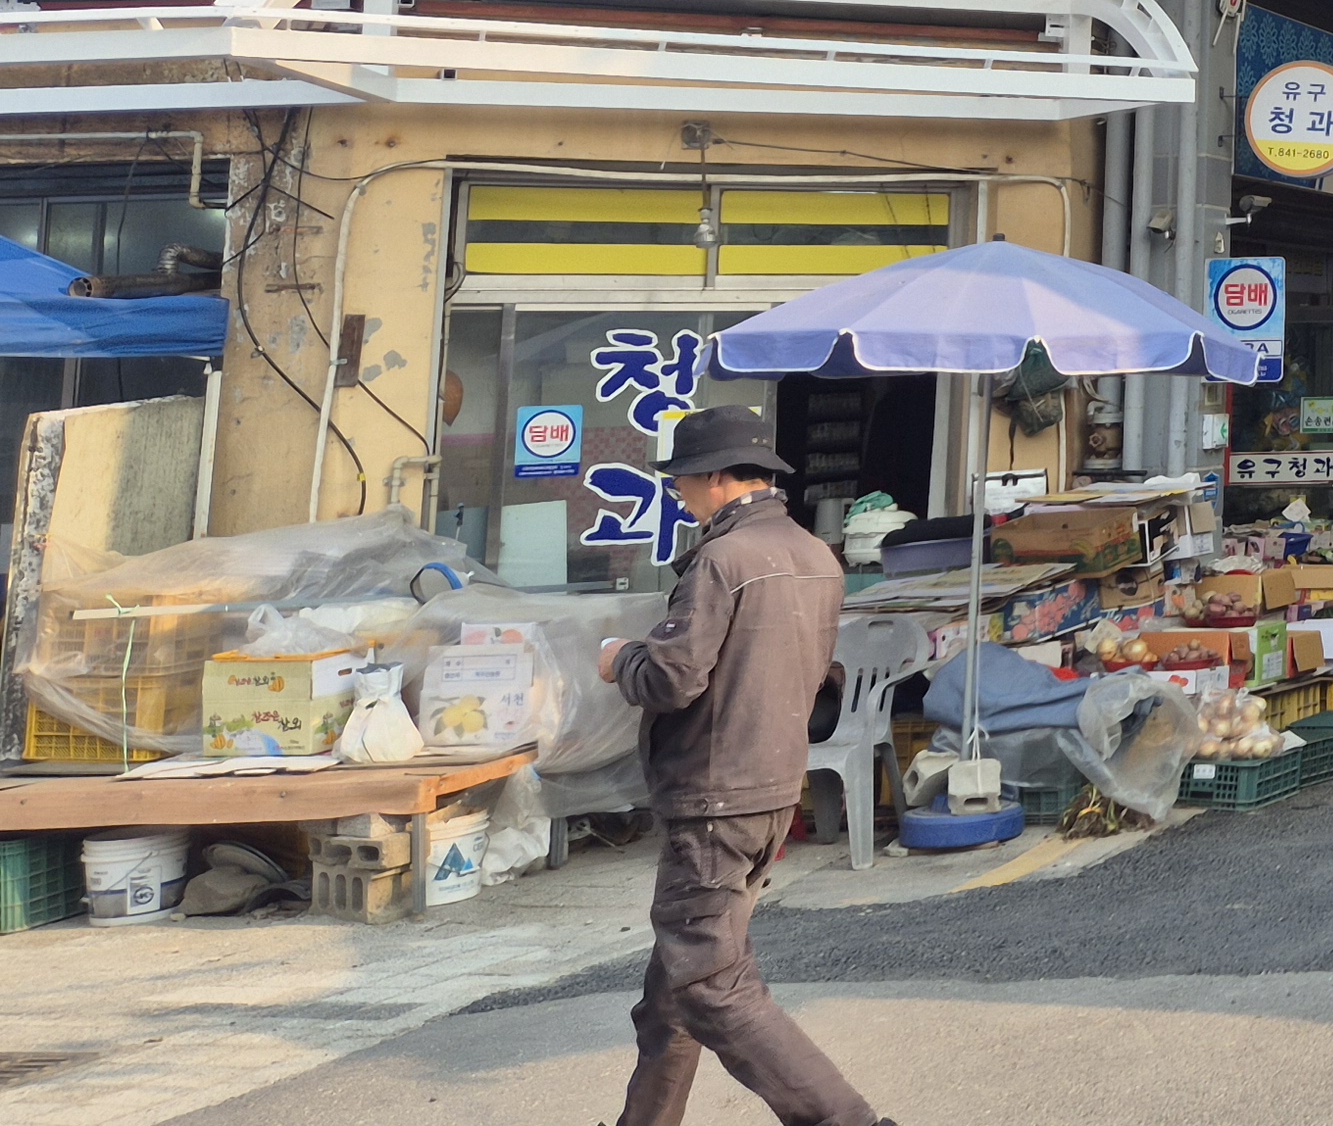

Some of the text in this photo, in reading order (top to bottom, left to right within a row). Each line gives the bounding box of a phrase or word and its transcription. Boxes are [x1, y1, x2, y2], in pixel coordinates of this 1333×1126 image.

[1281, 80, 1327, 103] 유구
[1267, 147, 1330, 161] T.841-2680
[1224, 282, 1269, 308] 담배
[529, 424, 570, 443] 담배
[1236, 456, 1333, 479] 유구청과
